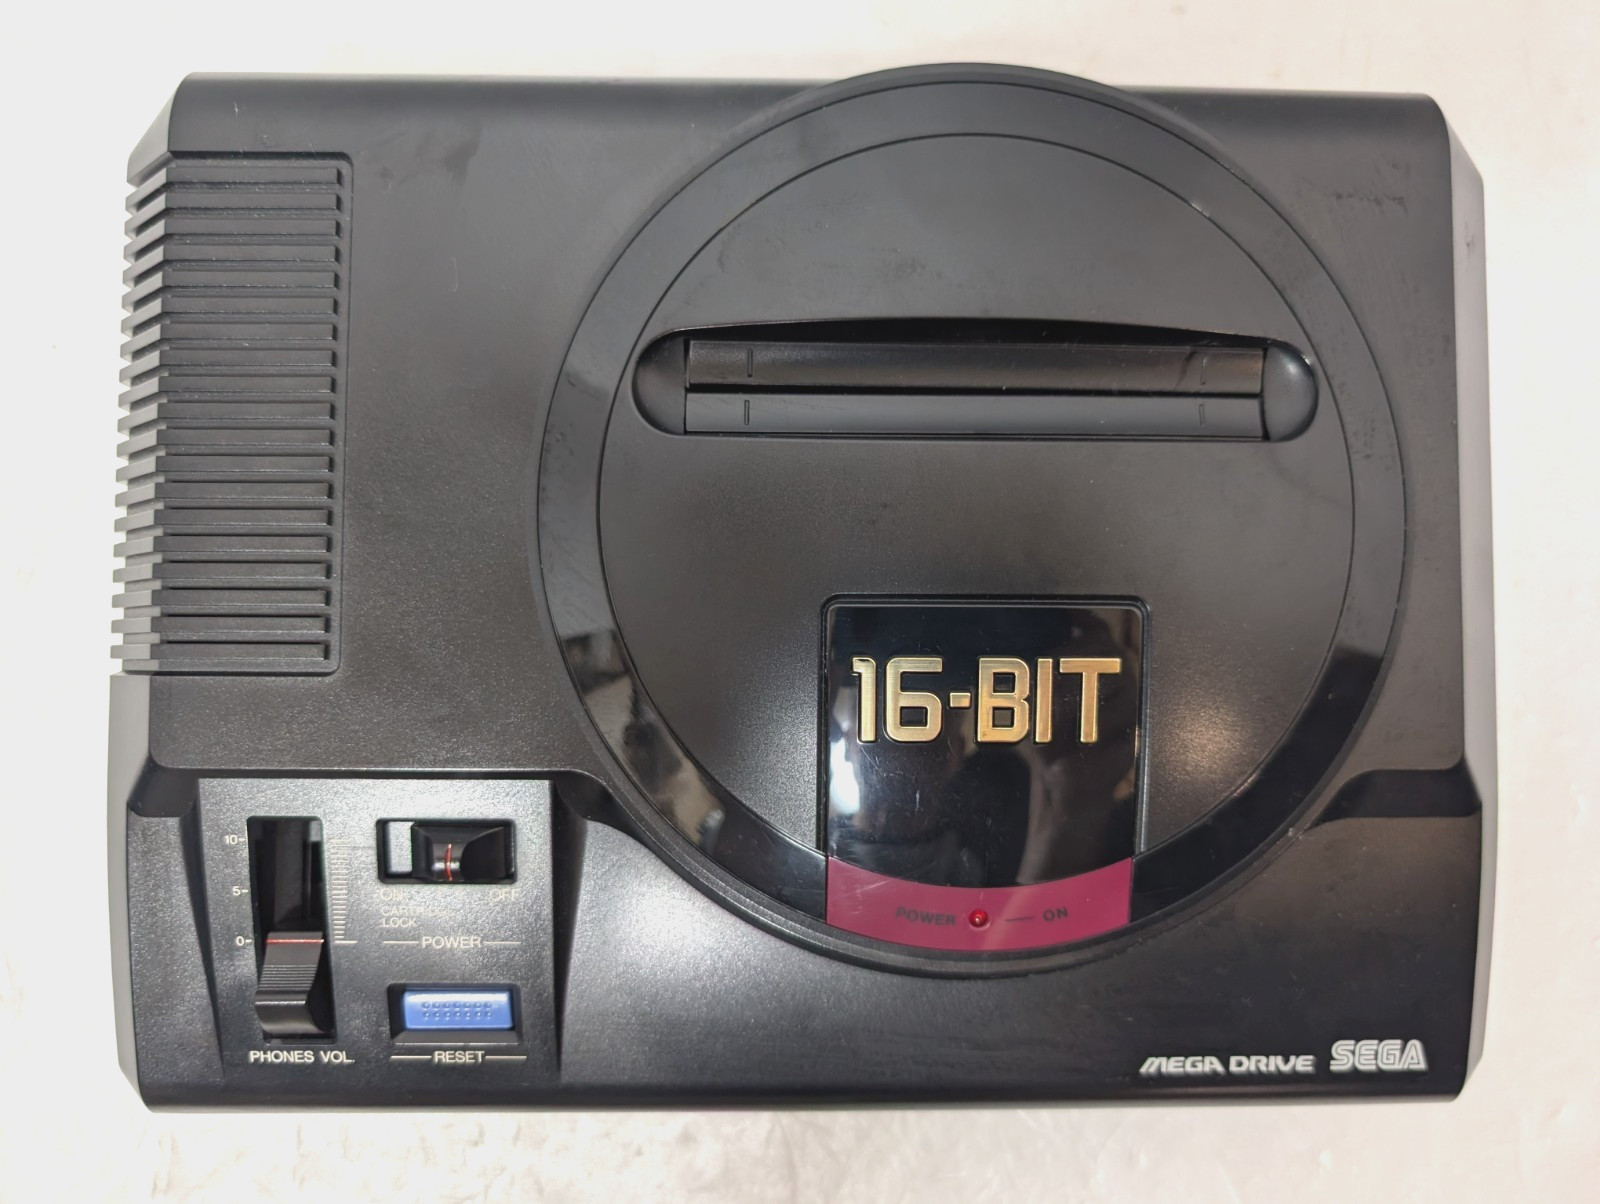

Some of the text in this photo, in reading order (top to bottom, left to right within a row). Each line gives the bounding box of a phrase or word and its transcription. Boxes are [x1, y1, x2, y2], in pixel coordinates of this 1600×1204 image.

[851, 656, 1122, 744] 16-BIT
[224, 834, 238, 845] 10
[232, 885, 241, 896] 5
[380, 888, 404, 901] ON
[489, 888, 520, 901] OFF
[382, 917, 417, 928] LOCK
[895, 907, 1068, 925] POWER ON
[422, 936, 482, 949] POWER
[249, 1051, 355, 1063] PHONES VOL.
[434, 1051, 485, 1063] RESET
[1330, 1039, 1426, 1071] SEGA
[1139, 1055, 1315, 1073] MEGA DRIVE
